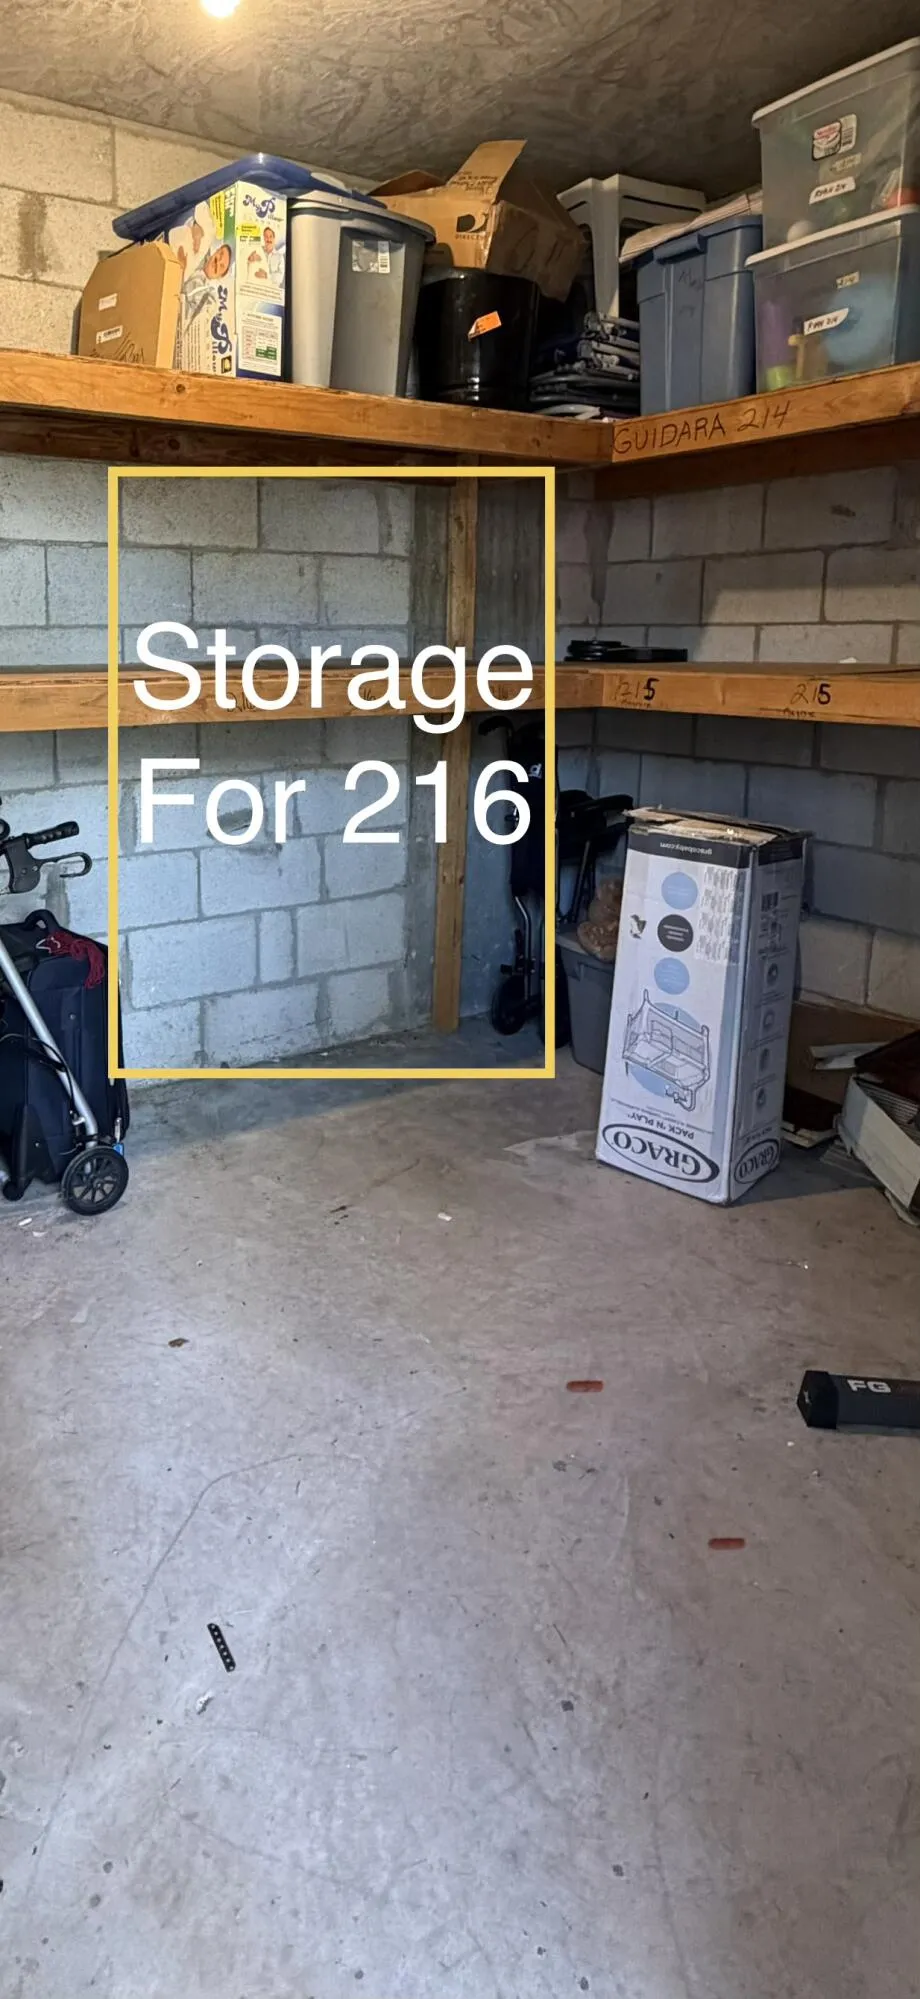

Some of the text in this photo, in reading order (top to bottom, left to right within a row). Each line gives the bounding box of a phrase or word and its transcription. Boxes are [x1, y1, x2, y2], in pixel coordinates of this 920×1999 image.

[613, 400, 791, 454] GUIDARA 214
[790, 683, 831, 705] 215
[668, 1127, 695, 1140] PACK
[613, 1131, 701, 1176] GRACO
[739, 1145, 777, 1178] GRACO
[847, 1379, 892, 1394] FG
